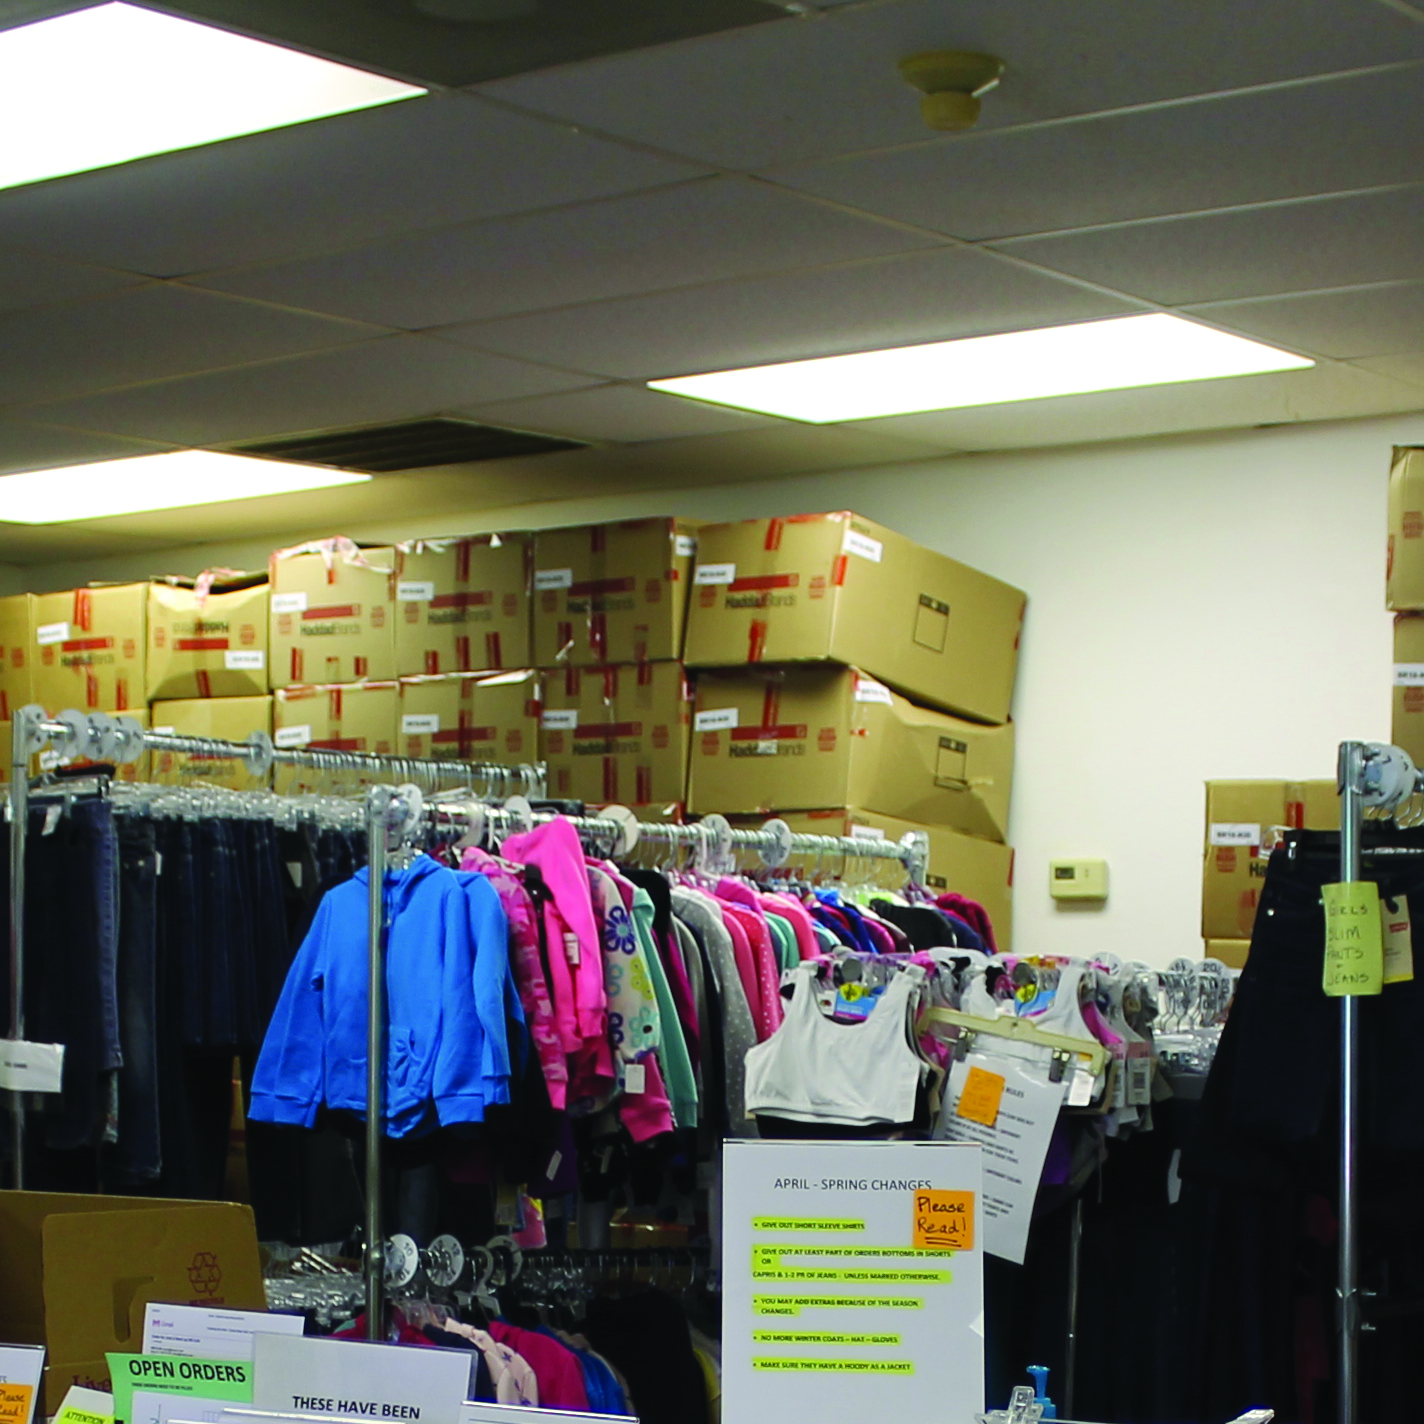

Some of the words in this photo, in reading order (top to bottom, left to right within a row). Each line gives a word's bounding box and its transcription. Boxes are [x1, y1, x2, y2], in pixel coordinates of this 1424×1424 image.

[774, 1178, 809, 1190] APRIL
[821, 1179, 867, 1190] SPRING
[871, 1179, 932, 1191] CHANGES
[917, 1196, 965, 1214] Please
[917, 1217, 966, 1237] Read!
[129, 1359, 175, 1378] OPEN
[179, 1363, 246, 1383] ORDERS
[293, 1396, 334, 1411] THESE
[337, 1400, 377, 1415] HAVE
[382, 1403, 420, 1419] BEEN
